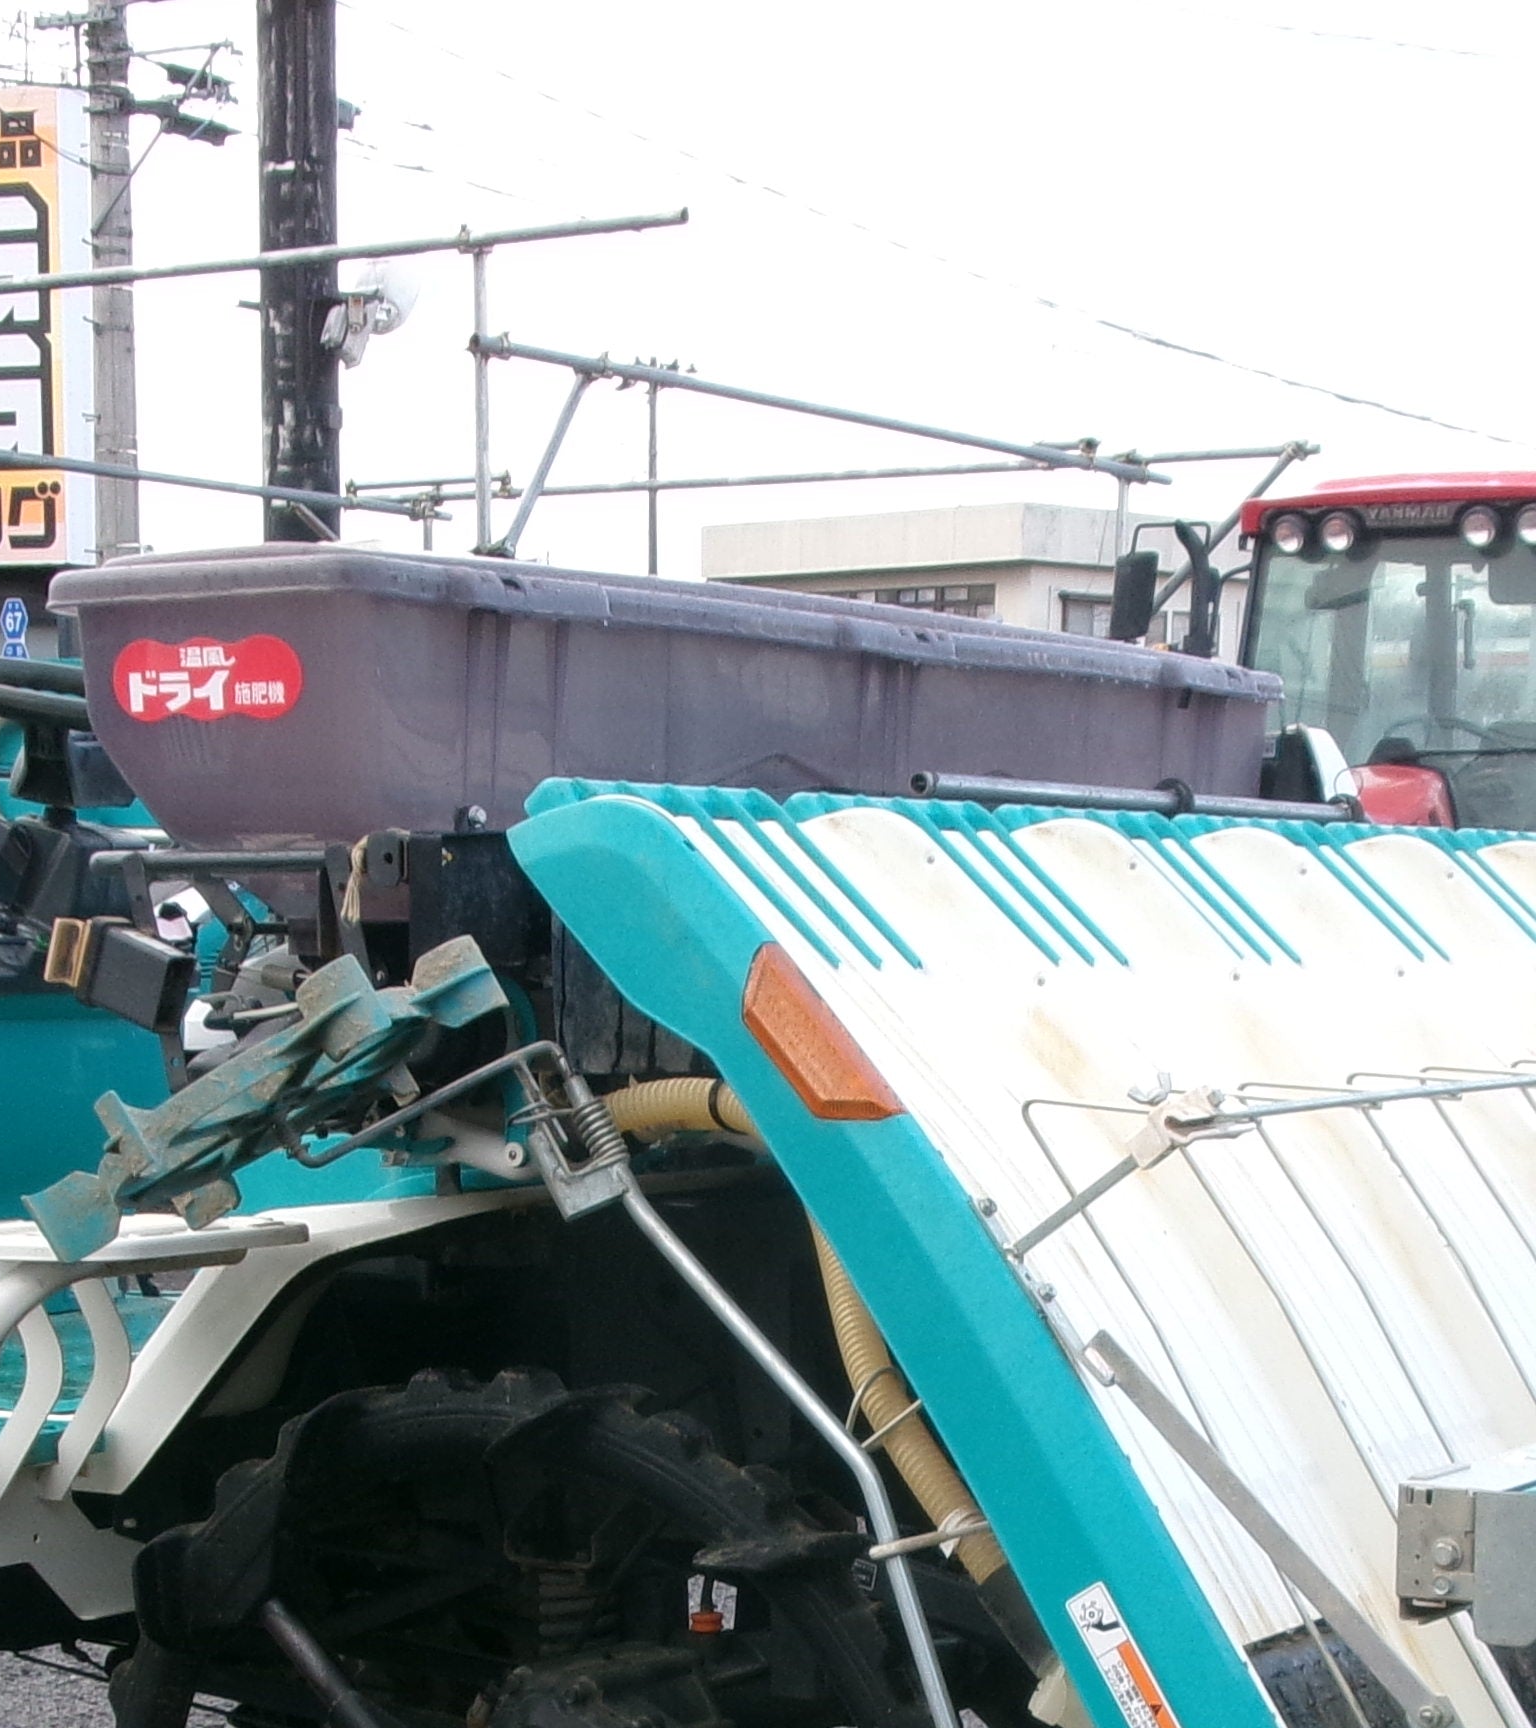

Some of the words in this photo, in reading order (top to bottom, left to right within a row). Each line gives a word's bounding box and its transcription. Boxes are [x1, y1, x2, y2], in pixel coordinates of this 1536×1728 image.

[1367, 505, 1449, 520] YANMAR
[5, 611, 23, 633] 67
[179, 645, 237, 668] 温風
[128, 669, 230, 713] ドライ
[234, 681, 286, 706] 施肥機
